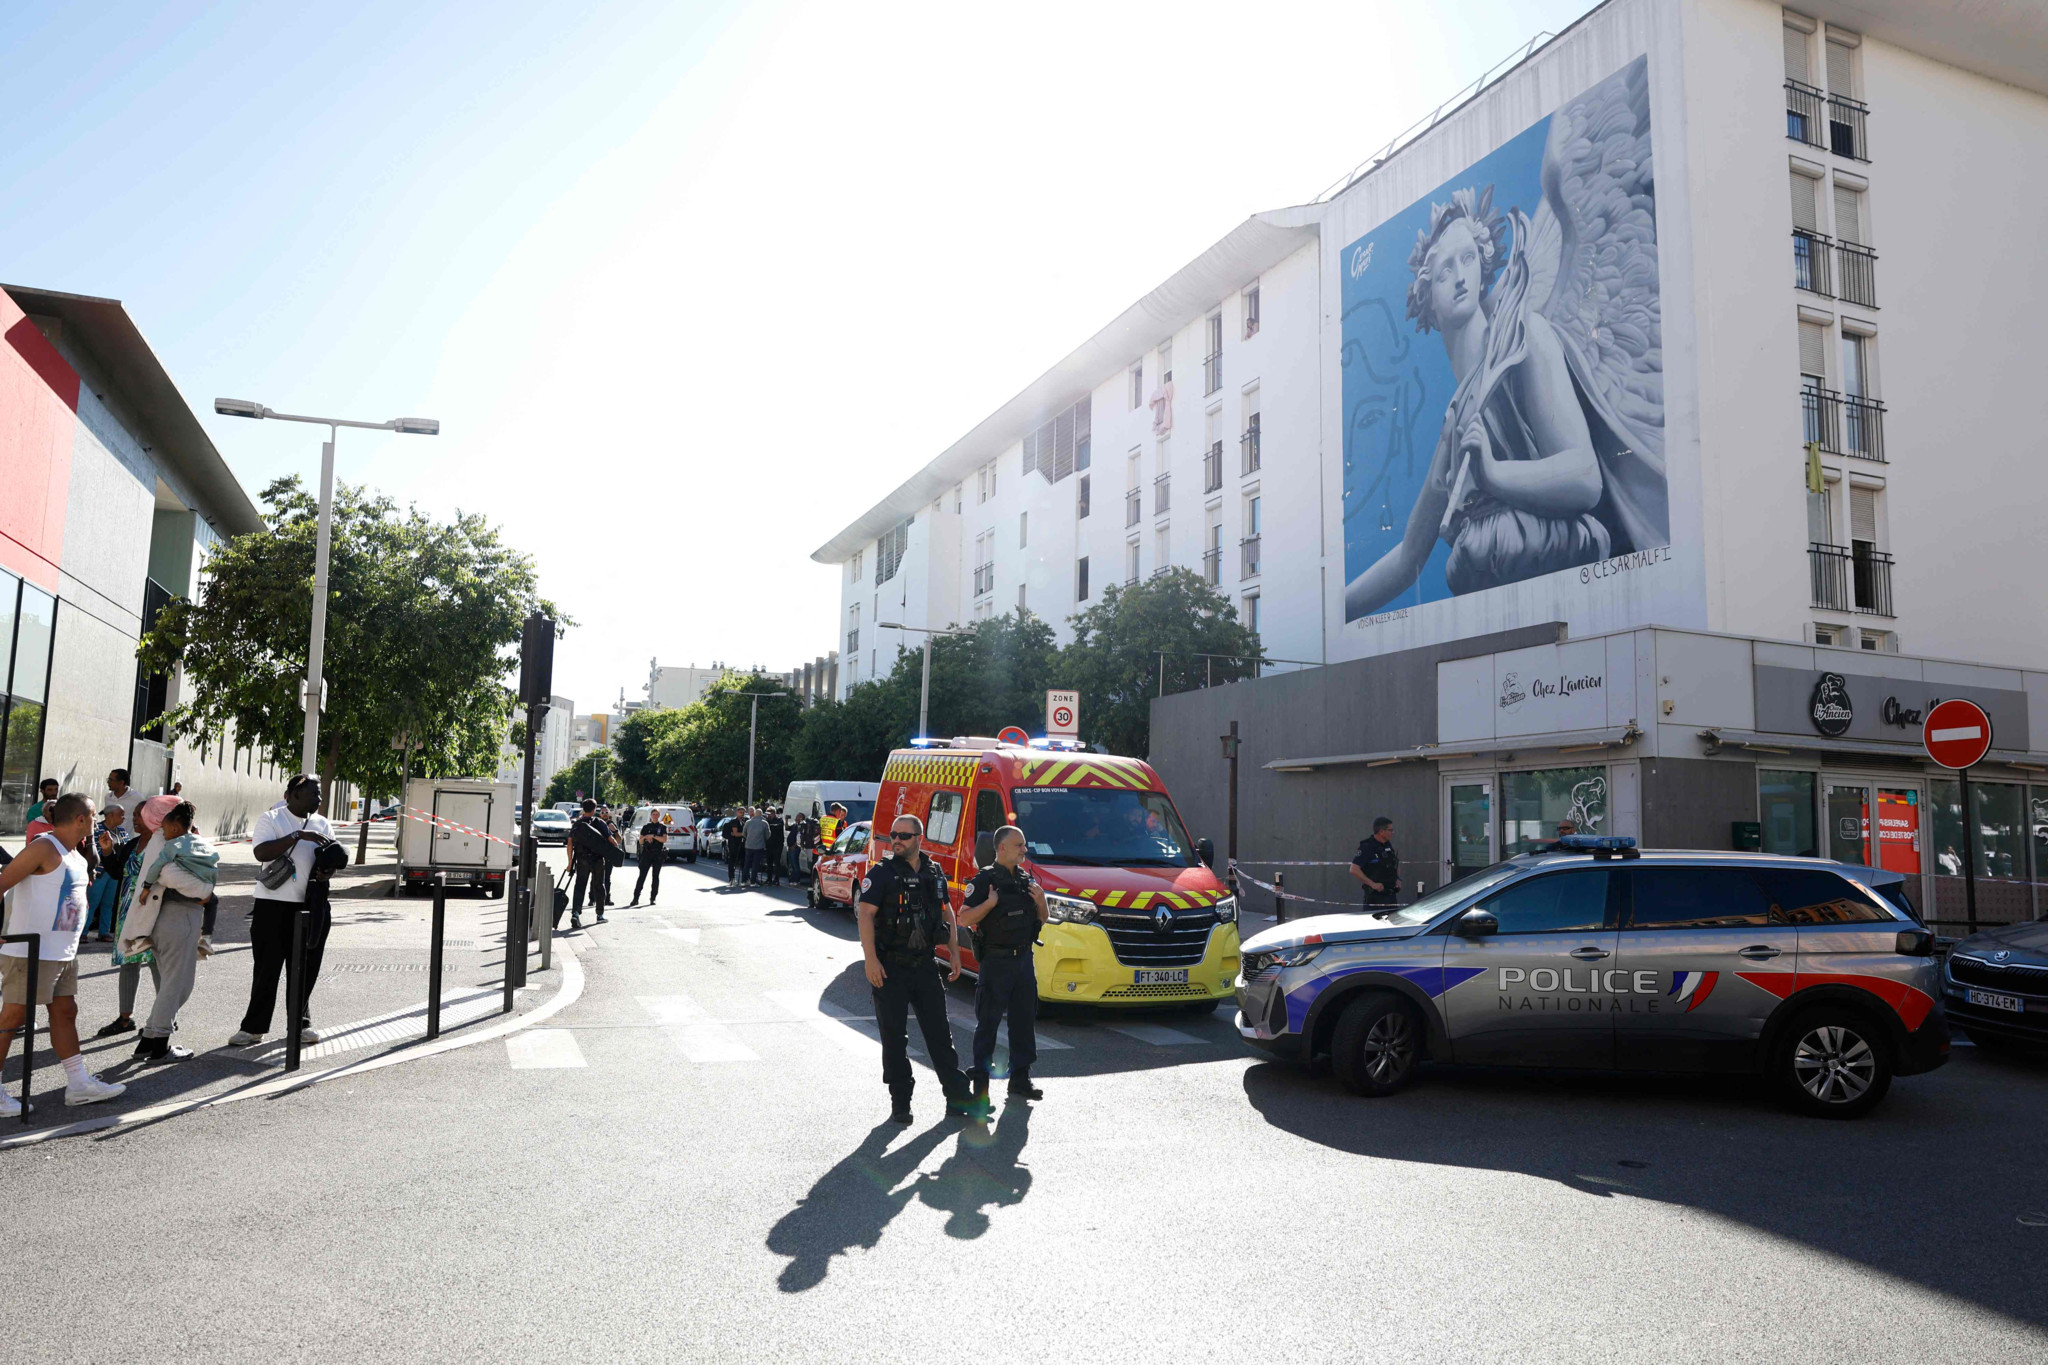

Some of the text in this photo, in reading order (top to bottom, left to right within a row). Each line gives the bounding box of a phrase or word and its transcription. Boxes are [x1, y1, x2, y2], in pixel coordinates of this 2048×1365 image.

[1532, 674, 1602, 699] Chez L'ancien
[1057, 712, 1069, 722] 30
[1883, 696, 1922, 729] Chez
[1140, 971, 1183, 982] FT-340-LC
[1498, 967, 1660, 994] POLICE
[1498, 995, 1660, 1014] NATIONALE
[1970, 990, 2017, 1011] HC-374-EM
